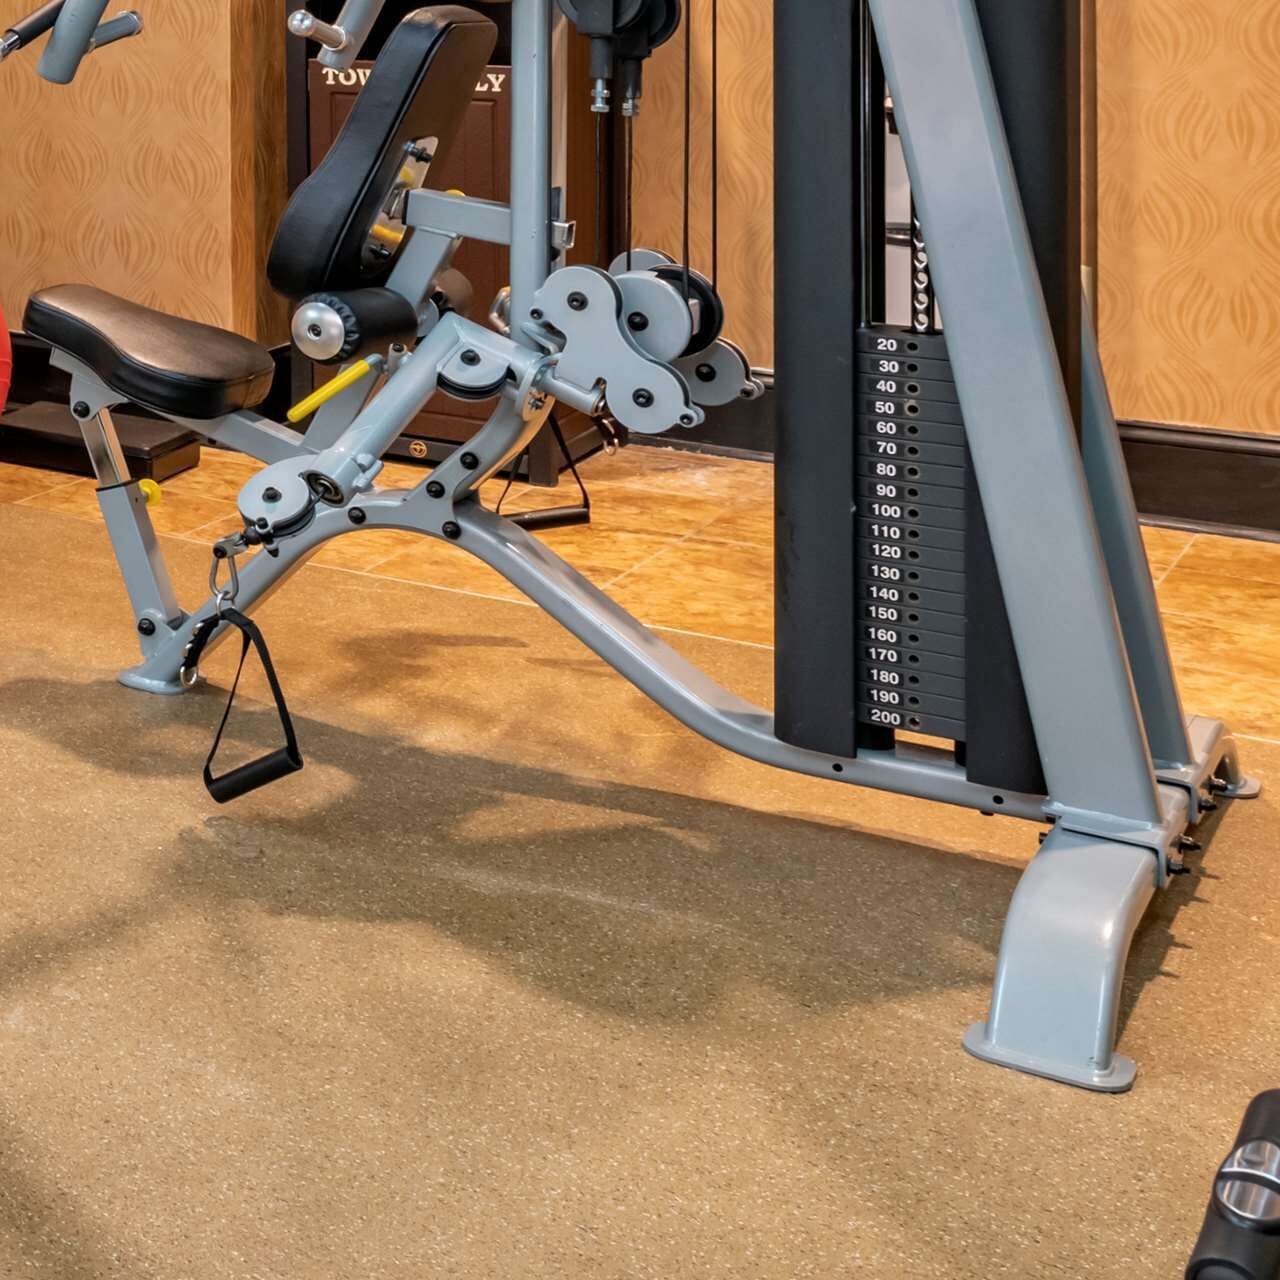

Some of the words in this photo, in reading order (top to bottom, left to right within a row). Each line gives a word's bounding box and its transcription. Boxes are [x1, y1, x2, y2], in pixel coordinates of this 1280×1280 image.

[877, 338, 897, 351] 20
[879, 360, 899, 373] 30
[876, 380, 896, 393] 40
[875, 401, 895, 414] 50
[876, 421, 896, 434] 60
[876, 441, 897, 455] 70
[876, 463, 896, 477] 80
[876, 484, 896, 497] 90
[872, 503, 901, 518] 100
[871, 524, 900, 539] 110
[872, 543, 901, 558] 120
[871, 564, 900, 580] 130
[869, 586, 899, 601] 140
[868, 606, 898, 621] 150
[868, 627, 897, 642] 160
[869, 647, 897, 662] 170
[870, 669, 899, 685] 180
[870, 689, 899, 704] 190
[871, 709, 901, 725] 200
